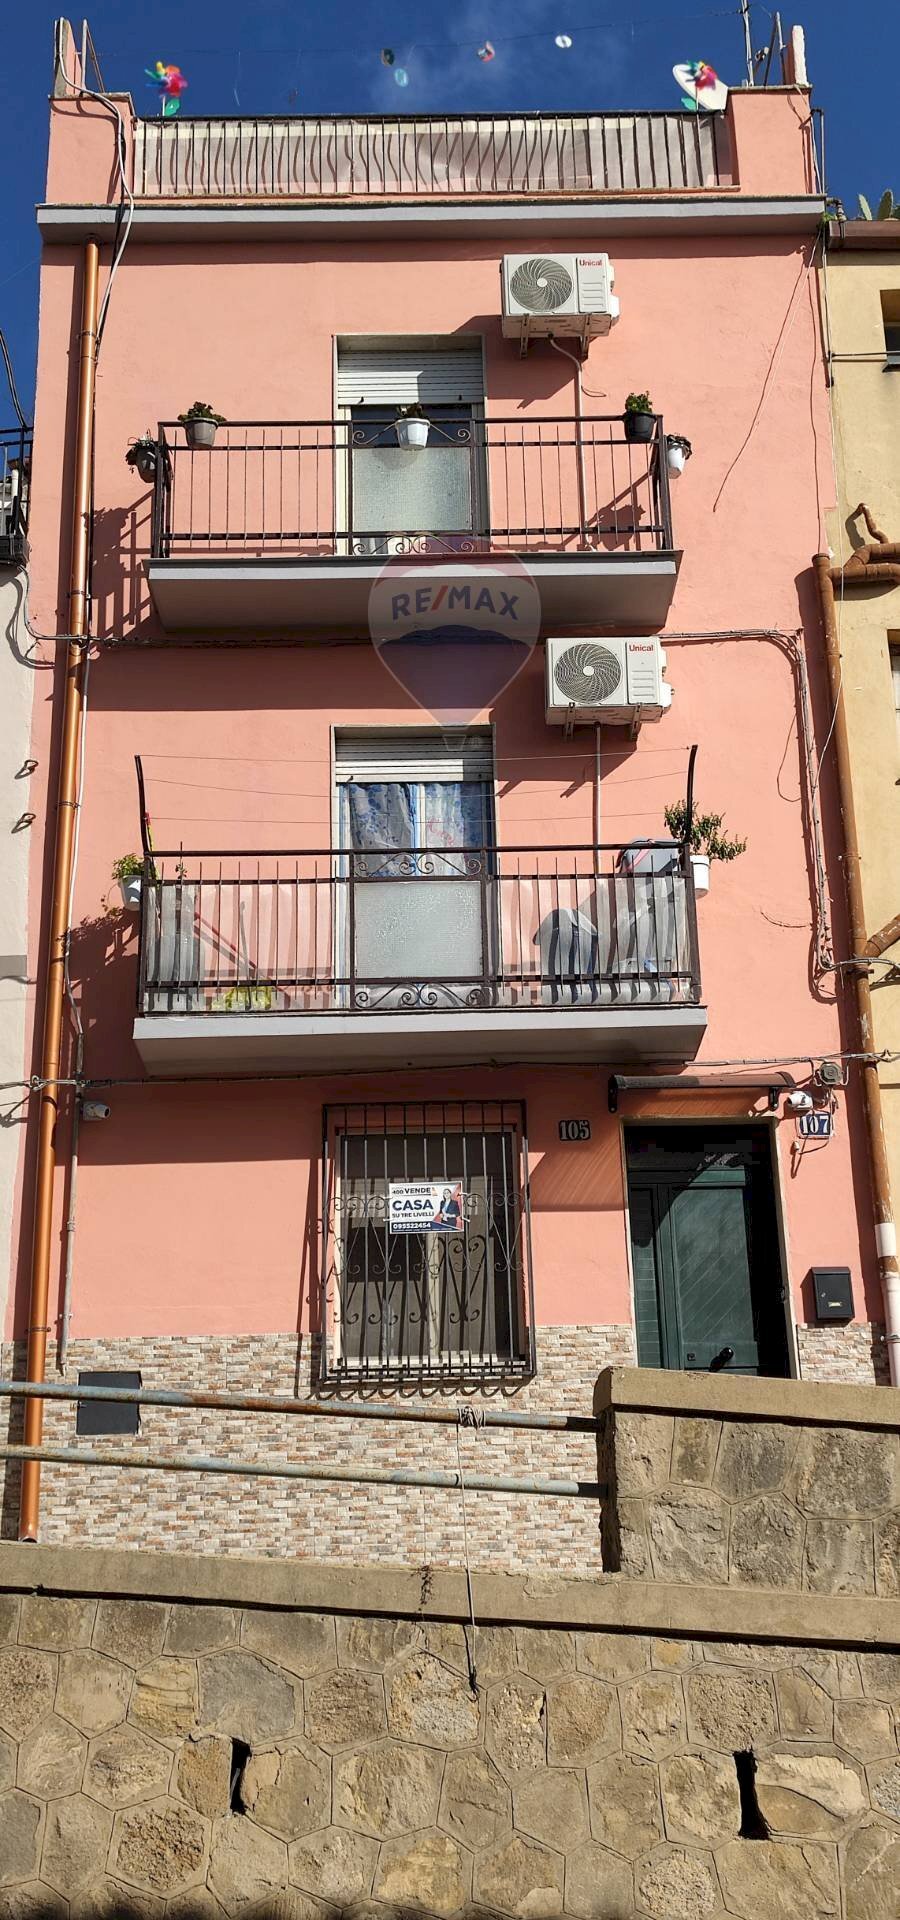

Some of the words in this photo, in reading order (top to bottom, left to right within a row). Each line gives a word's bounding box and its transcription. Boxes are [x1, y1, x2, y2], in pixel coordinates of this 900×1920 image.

[579, 258, 603, 267] Unical
[628, 644, 654, 652] Unical
[801, 1115, 829, 1134] 107
[560, 1120, 590, 1140] 105
[392, 1199, 434, 1211] CASA
[392, 1222, 431, 1230] 095522454
